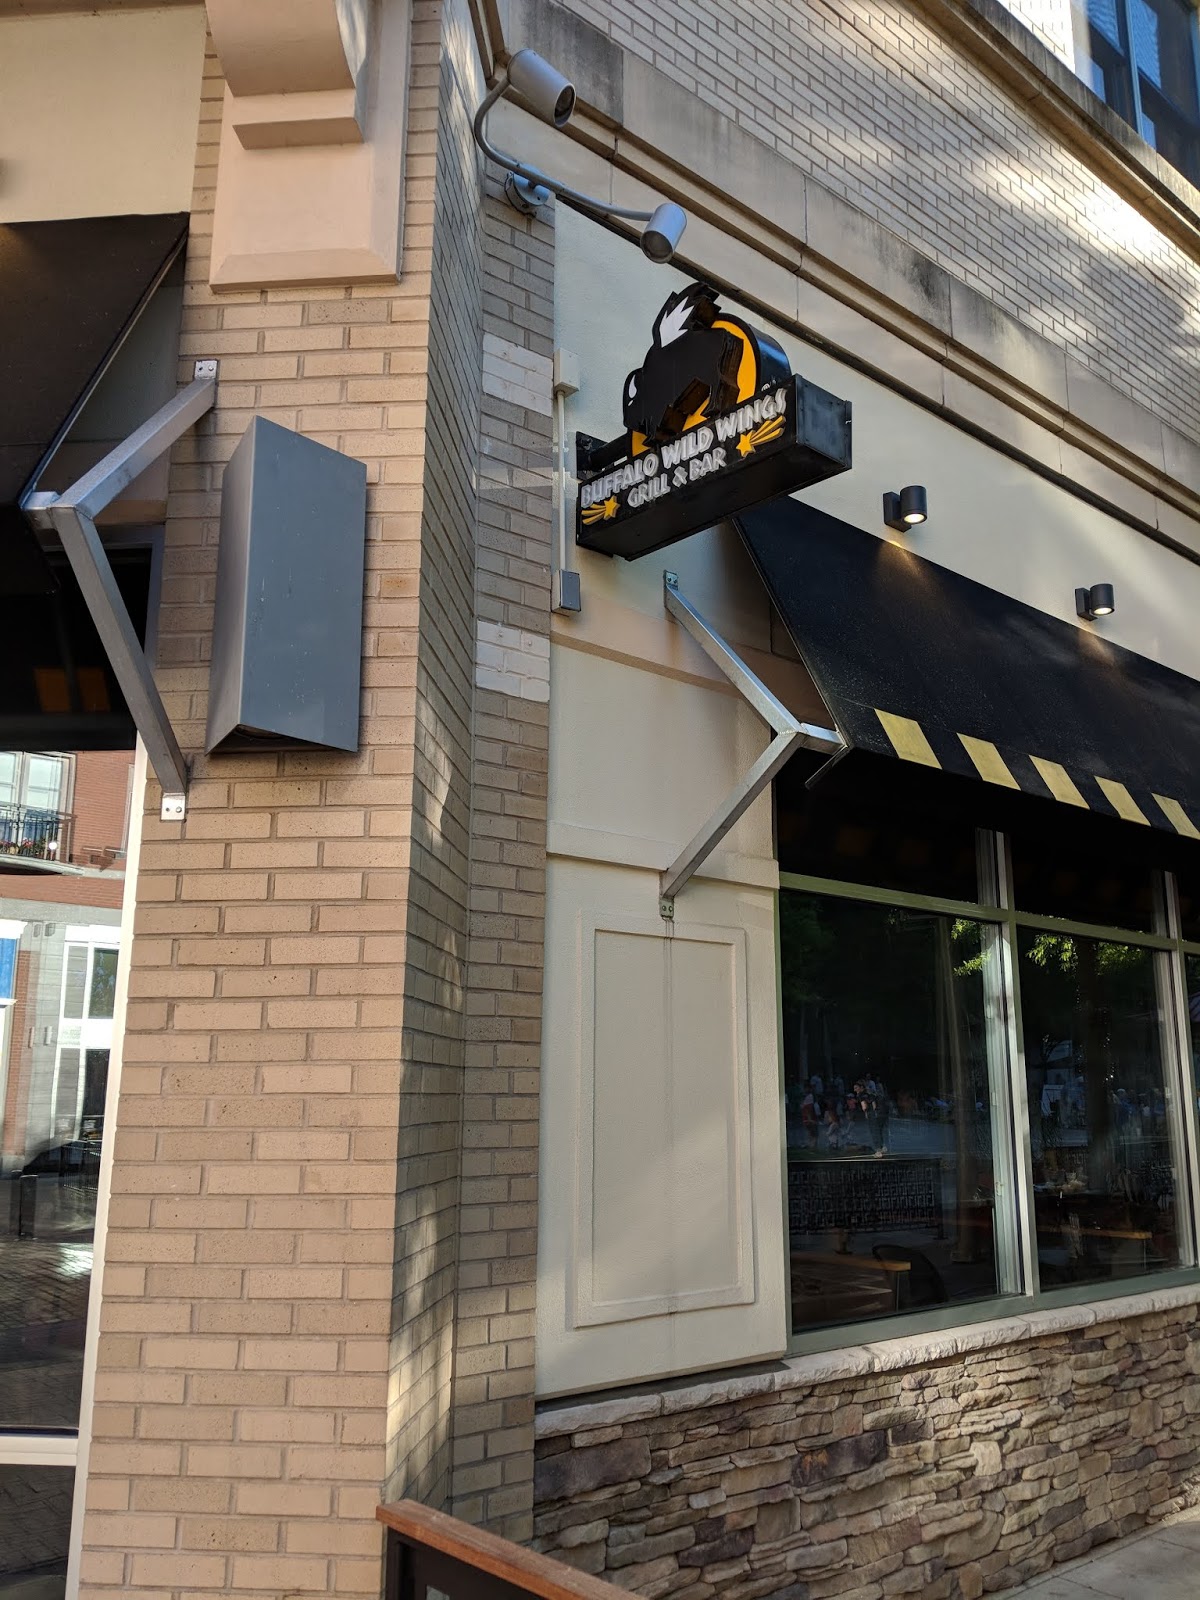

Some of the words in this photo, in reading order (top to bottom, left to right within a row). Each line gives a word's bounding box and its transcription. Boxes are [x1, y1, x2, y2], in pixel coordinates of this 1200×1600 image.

[581, 453, 659, 508] BUFFALO
[661, 426, 714, 469] WILD
[714, 388, 787, 442] WINGS
[627, 473, 671, 508] GRILL
[672, 466, 688, 488] &
[689, 446, 727, 481] BAR
